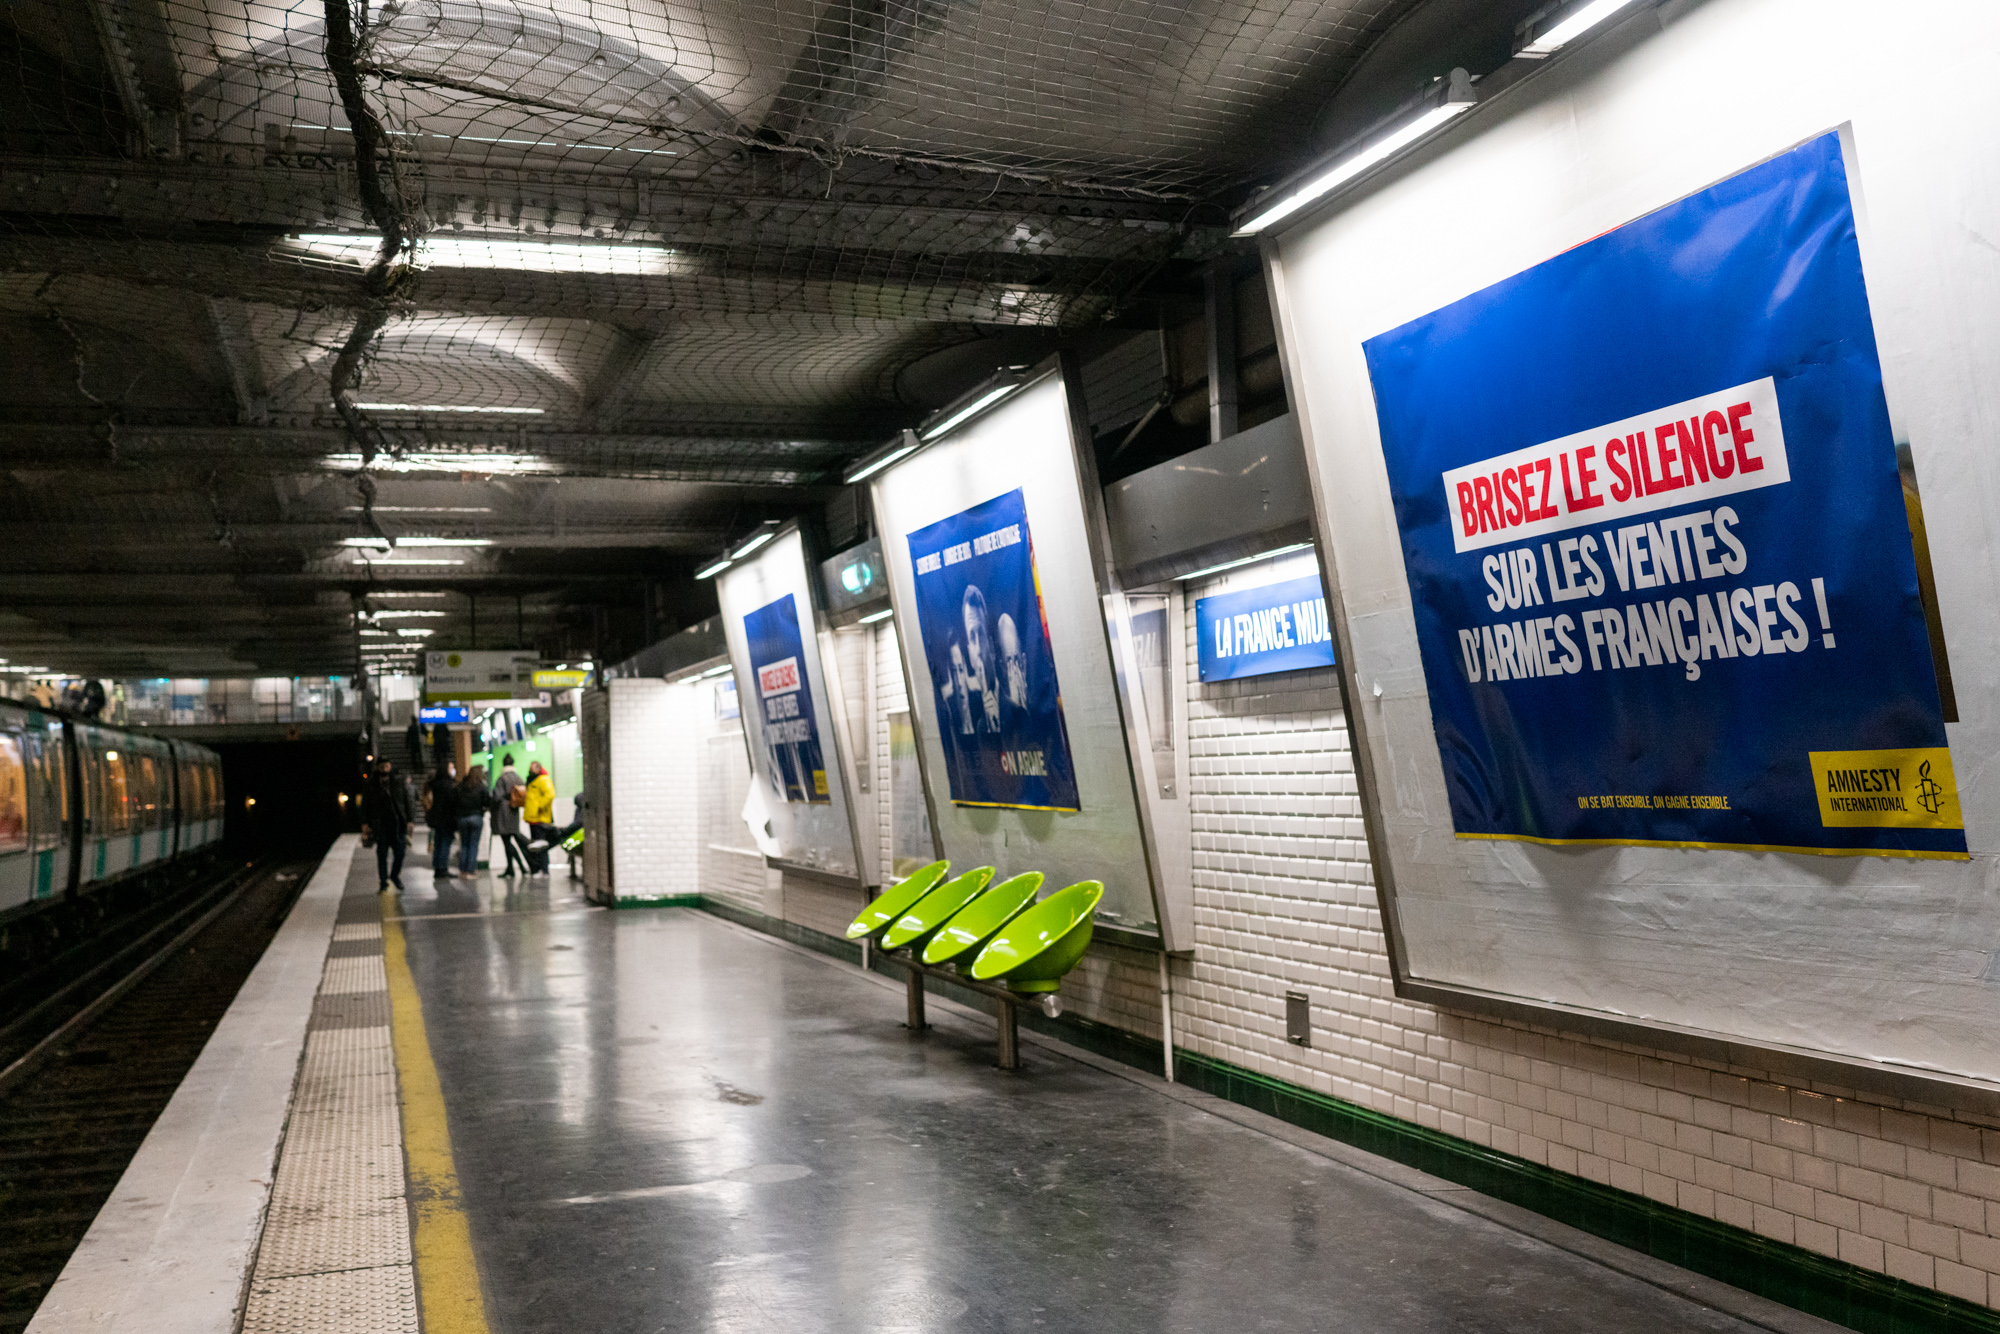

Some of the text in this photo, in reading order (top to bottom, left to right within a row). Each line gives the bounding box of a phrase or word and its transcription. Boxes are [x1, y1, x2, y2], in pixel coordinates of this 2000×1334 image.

[1457, 402, 1765, 537] BRISEZ LE SILENCE
[1483, 506, 1747, 612] SUR LES VENTES
[1215, 617, 1233, 659] LA
[1234, 605, 1295, 655] FRANCE
[1458, 614, 1583, 684] D'ARMES
[1583, 581, 1809, 681] FRANÇAISES
[420, 708, 447, 719] Sortie
[1001, 751, 1018, 776] ON
[1827, 769, 1901, 793] AMNESTY
[1577, 795, 1732, 810] ON SE BAT ENSEMBLE, ON GAGNE ENSEMBLE.
[1830, 797, 1909, 812] INTERNATIONAL
